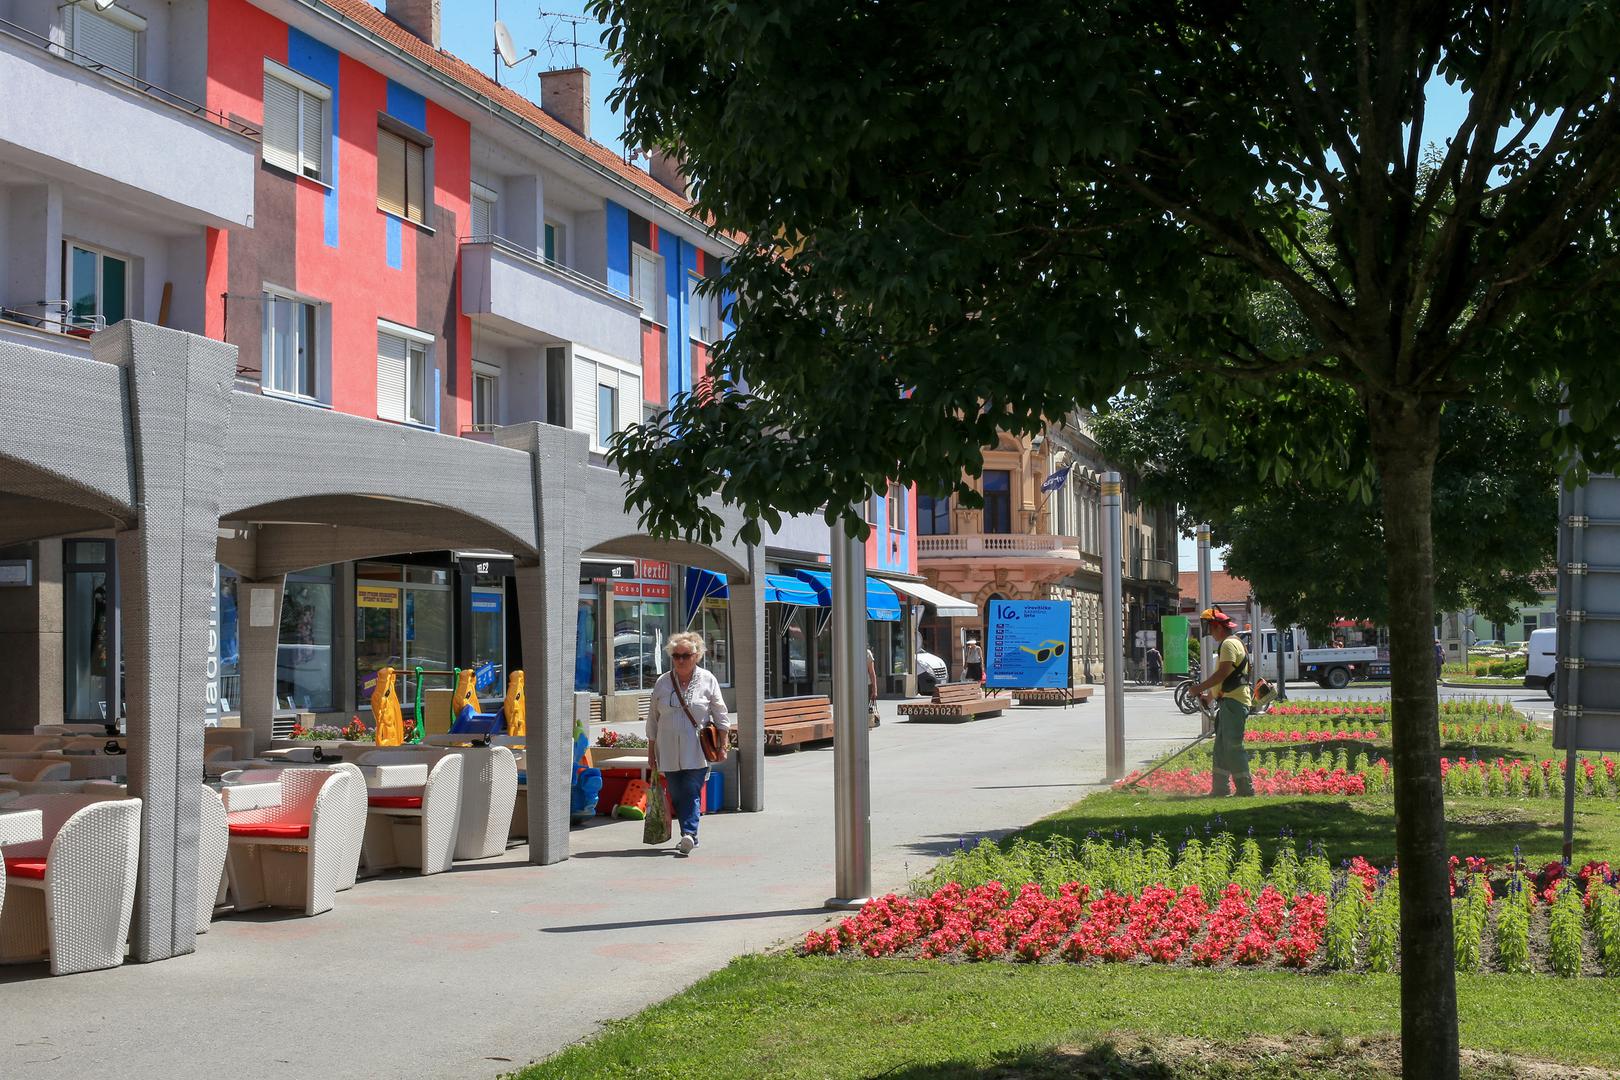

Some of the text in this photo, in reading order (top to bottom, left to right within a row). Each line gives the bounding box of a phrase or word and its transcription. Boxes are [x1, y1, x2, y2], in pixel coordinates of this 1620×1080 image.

[643, 563, 668, 579] textil
[615, 585, 640, 593] ECOND
[998, 605, 1020, 620] 16.
